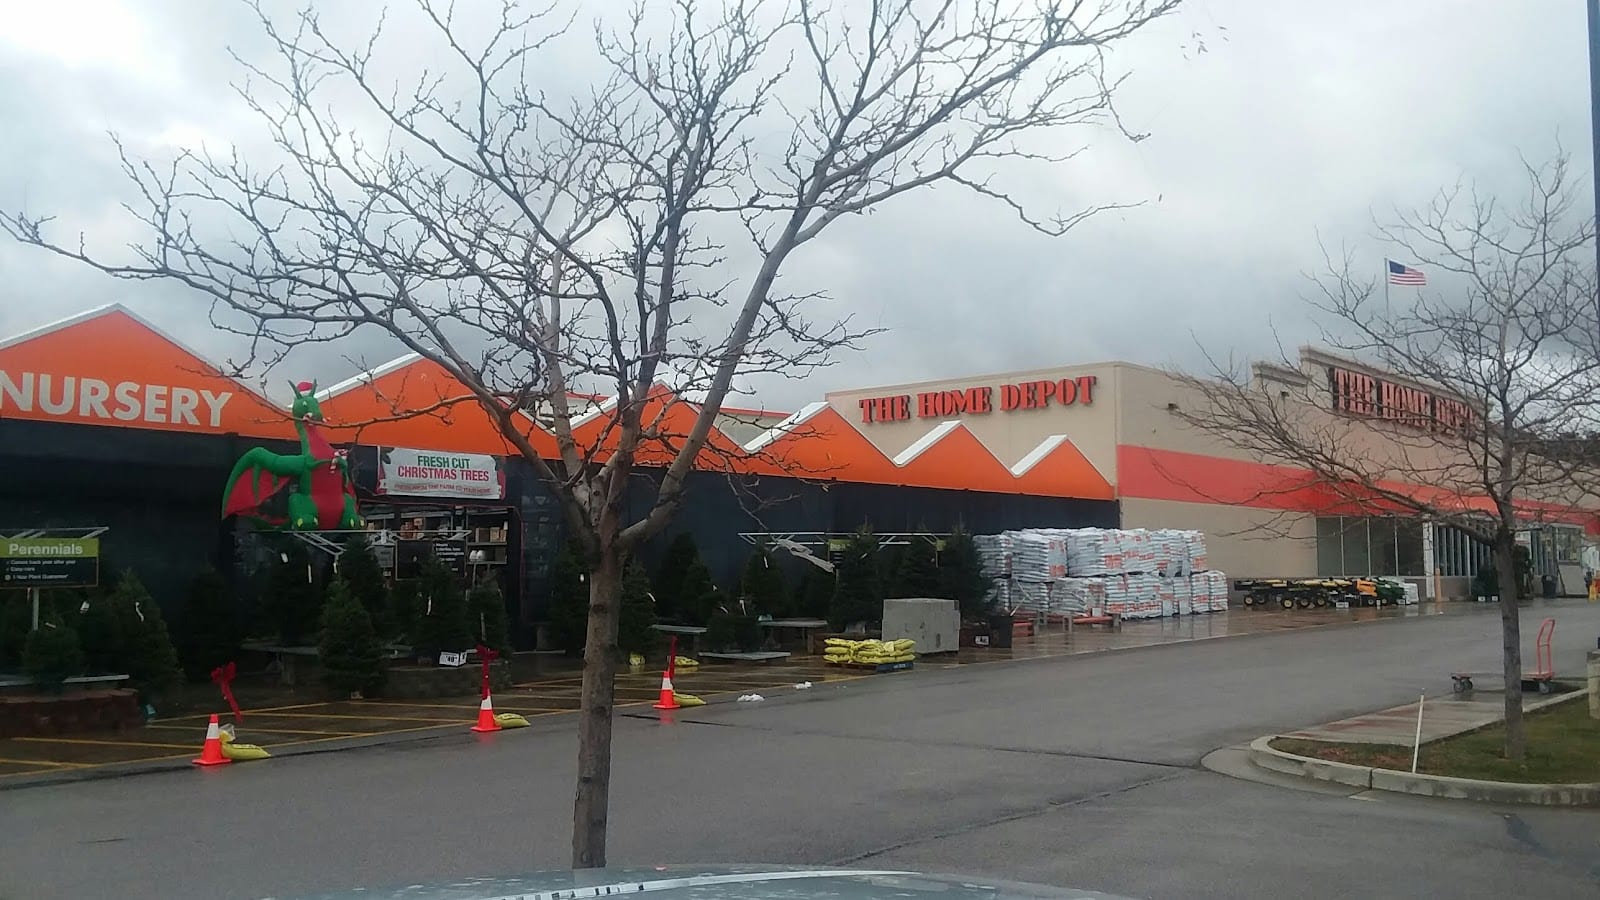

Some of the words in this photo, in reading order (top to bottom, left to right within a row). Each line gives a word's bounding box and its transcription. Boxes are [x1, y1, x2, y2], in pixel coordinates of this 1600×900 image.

[0, 370, 232, 427] NURSERY
[859, 395, 910, 424] THE
[917, 387, 992, 419] HOME
[1000, 376, 1096, 412] DEPOT
[1333, 367, 1376, 416] THE
[398, 465, 457, 480] CHRISTMAS
[460, 469, 489, 482] TREES
[417, 455, 449, 468] FRESH
[451, 457, 470, 469] CUT
[8, 543, 83, 555] Perennials
